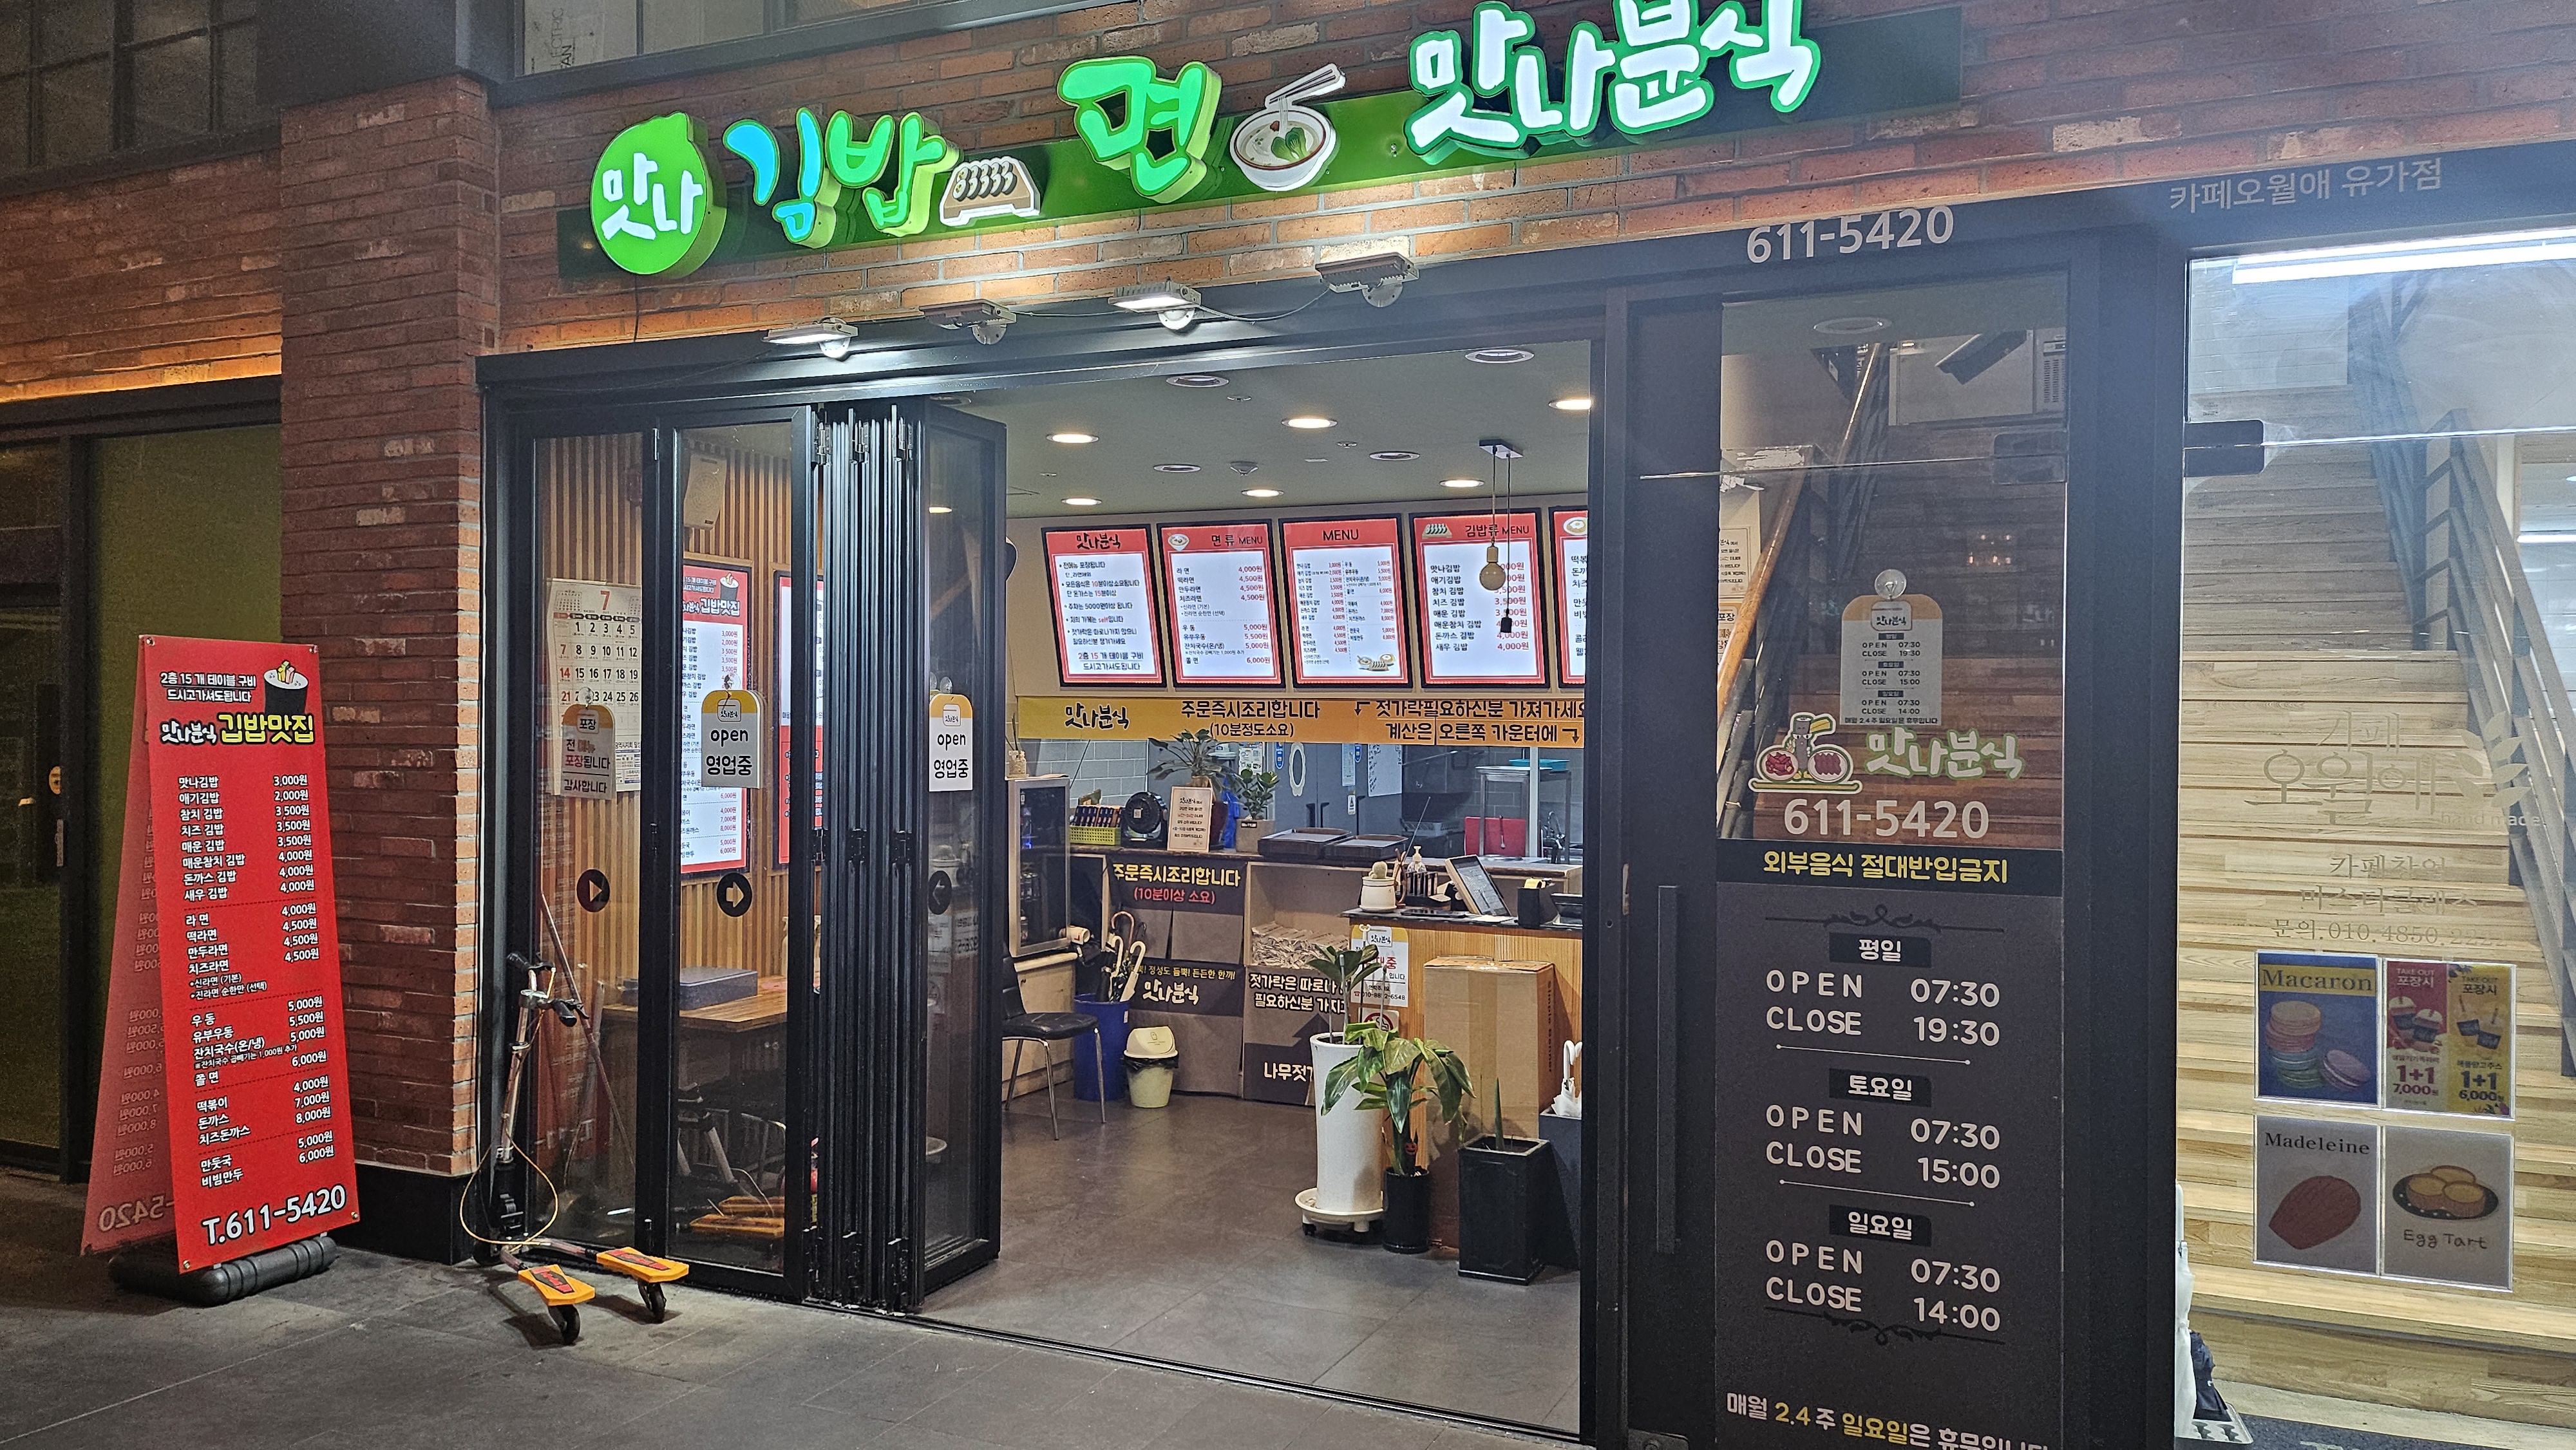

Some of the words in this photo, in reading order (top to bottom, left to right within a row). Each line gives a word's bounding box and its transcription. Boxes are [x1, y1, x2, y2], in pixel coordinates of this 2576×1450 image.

[1405, 0, 1821, 158] 맛나분식
[1058, 55, 1217, 201] 면
[723, 108, 950, 246] 김밥
[2170, 169, 2330, 213] 카페오월애
[2342, 158, 2442, 196] 유가점
[601, 153, 703, 240] 맛나
[1747, 205, 1954, 263] 611-5420
[1077, 532, 1121, 550] 맛나분식
[1323, 529, 1359, 541] MENU
[1465, 524, 1499, 538] 김밥류
[1502, 526, 1530, 534] MENU
[1430, 565, 1461, 573] 맛나김밥
[1430, 576, 1461, 585] 애기김밥
[600, 590, 611, 610] 7
[1450, 598, 1465, 607] 김밥
[1495, 597, 1526, 606] 3,500원
[1876, 615, 1907, 626] 맛나분식
[602, 646, 611, 656] 10
[616, 646, 625, 657] 11
[1497, 641, 1530, 650] 4,000원
[160, 672, 178, 684] 2층
[180, 673, 192, 684] 15
[194, 673, 205, 686] 개
[207, 674, 236, 687] 테이블
[238, 675, 256, 688] 구비
[167, 689, 252, 703] 드시고가셔도됩니다
[1065, 702, 1130, 730] 맛나분식
[1180, 699, 1320, 719] 주문즉시조리합니다
[1375, 699, 1504, 719] 젓가락필요하신분
[162, 720, 218, 744] 맛나분식
[580, 718, 597, 731] 포장
[1209, 722, 1294, 737] (10분정도소요)
[1385, 722, 1432, 740] 계산은
[1438, 722, 1486, 741] 오른쪽
[1490, 723, 1558, 743] 카운터에
[566, 739, 575, 752] 전
[710, 729, 749, 748] open
[937, 733, 967, 751] open
[564, 754, 611, 770] 포장됩니다
[1866, 728, 2026, 780] 맛나분식
[706, 755, 753, 776] 영업중
[934, 758, 969, 778] 영업중
[178, 777, 219, 789] 맛나김밥
[274, 775, 308, 786] 3,000원
[564, 778, 607, 793] 감사합니다
[178, 792, 220, 804] 애기김밥
[274, 789, 309, 802] 2,000원
[180, 809, 200, 820] 참치
[204, 808, 223, 820] 김밥
[275, 804, 310, 820] 3,500원
[1784, 798, 1990, 838] 611-5420
[181, 825, 202, 837] 치즈
[204, 824, 224, 836] 김밥
[276, 819, 311, 832] 3,500원
[182, 841, 203, 853] 매운
[205, 840, 225, 852] 김밥
[277, 834, 312, 847] 3,500원
[182, 856, 223, 869] 매운참치
[225, 854, 245, 867] 김밥
[278, 849, 313, 862] 4,000원
[1763, 851, 1853, 878] 외부음식
[1861, 854, 2008, 883] 절대반입금지
[2329, 853, 2448, 881] 카페창업
[184, 872, 215, 885] 돈까스
[216, 871, 237, 883] 김밥
[279, 864, 314, 878] 4,000원
[1112, 863, 1241, 887] 주문즉시조리합니다
[184, 889, 205, 901] 새우
[207, 887, 228, 899] 김밥
[280, 880, 315, 893] 4,000원
[1133, 887, 1186, 903] (10분이상
[1188, 890, 1216, 905] 소요)
[281, 903, 317, 917] 4,000원
[187, 929, 218, 943] 떡라면
[282, 918, 317, 932] 4,500원
[1370, 934, 1391, 945] 맛나분식
[187, 943, 229, 959] 만두라면
[283, 933, 319, 947] 4,500원
[1858, 938, 1902, 963] 평일
[189, 959, 230, 975] 치즈라면
[285, 948, 319, 963] 4,500원
[1148, 965, 1171, 977] 정성도
[1192, 968, 1216, 980] 든든한
[1249, 973, 1298, 992] 젓가락은
[2262, 968, 2374, 992] Macaron
[2396, 975, 2434, 988] 포장시
[1142, 978, 1200, 1006] 맛나분식
[1766, 969, 1863, 999] OPEN
[1910, 978, 2000, 1008] 07:30
[2462, 983, 2497, 996] 포장시
[288, 996, 323, 1012] 5,000원
[1255, 992, 1314, 1012] 필요하신분
[192, 1026, 234, 1044] 유부우동
[289, 1011, 324, 1026] 5,500원
[1766, 1006, 1862, 1036] CLOSE
[1913, 1016, 2000, 1047] 19:30
[194, 1037, 265, 1060] 잔치국수(온/냉)
[290, 1026, 325, 1042] 5,000원
[292, 1050, 327, 1067] 6,000원
[2396, 1064, 2435, 1084] 1+1
[2460, 1070, 2497, 1091] 1+1
[196, 1096, 228, 1113] 떡볶이
[293, 1075, 329, 1093] 4,000원
[1848, 1075, 1913, 1102] 토요일
[198, 1113, 230, 1130] 돈까스
[294, 1091, 330, 1108] 7,000원
[198, 1125, 251, 1145] 치즈돈까스
[296, 1106, 332, 1124] 8,000원
[1766, 1104, 1863, 1136] OPEN
[1910, 1118, 2000, 1151] 07:30
[200, 1154, 232, 1172] 만둣국
[298, 1130, 333, 1149] 5,000원
[2265, 1132, 2371, 1155] Madeleine
[201, 1168, 244, 1188] 비빔만두
[299, 1145, 335, 1164] 6,000원
[1766, 1141, 1862, 1174] CLOSE
[1917, 1156, 2000, 1189] 15:00
[201, 1184, 347, 1245] T.611-5420
[1848, 1210, 1913, 1241] 일요일
[2403, 1229, 2438, 1248] Egg
[2443, 1232, 2488, 1250] Tart
[1766, 1239, 1863, 1275] OPEN
[1910, 1258, 2001, 1294] 07:30
[1766, 1276, 1862, 1313] CLOSE
[1913, 1297, 2001, 1332] 14:00
[1727, 1392, 1768, 1421] 매월
[1842, 1412, 1931, 1449] 일요일은
